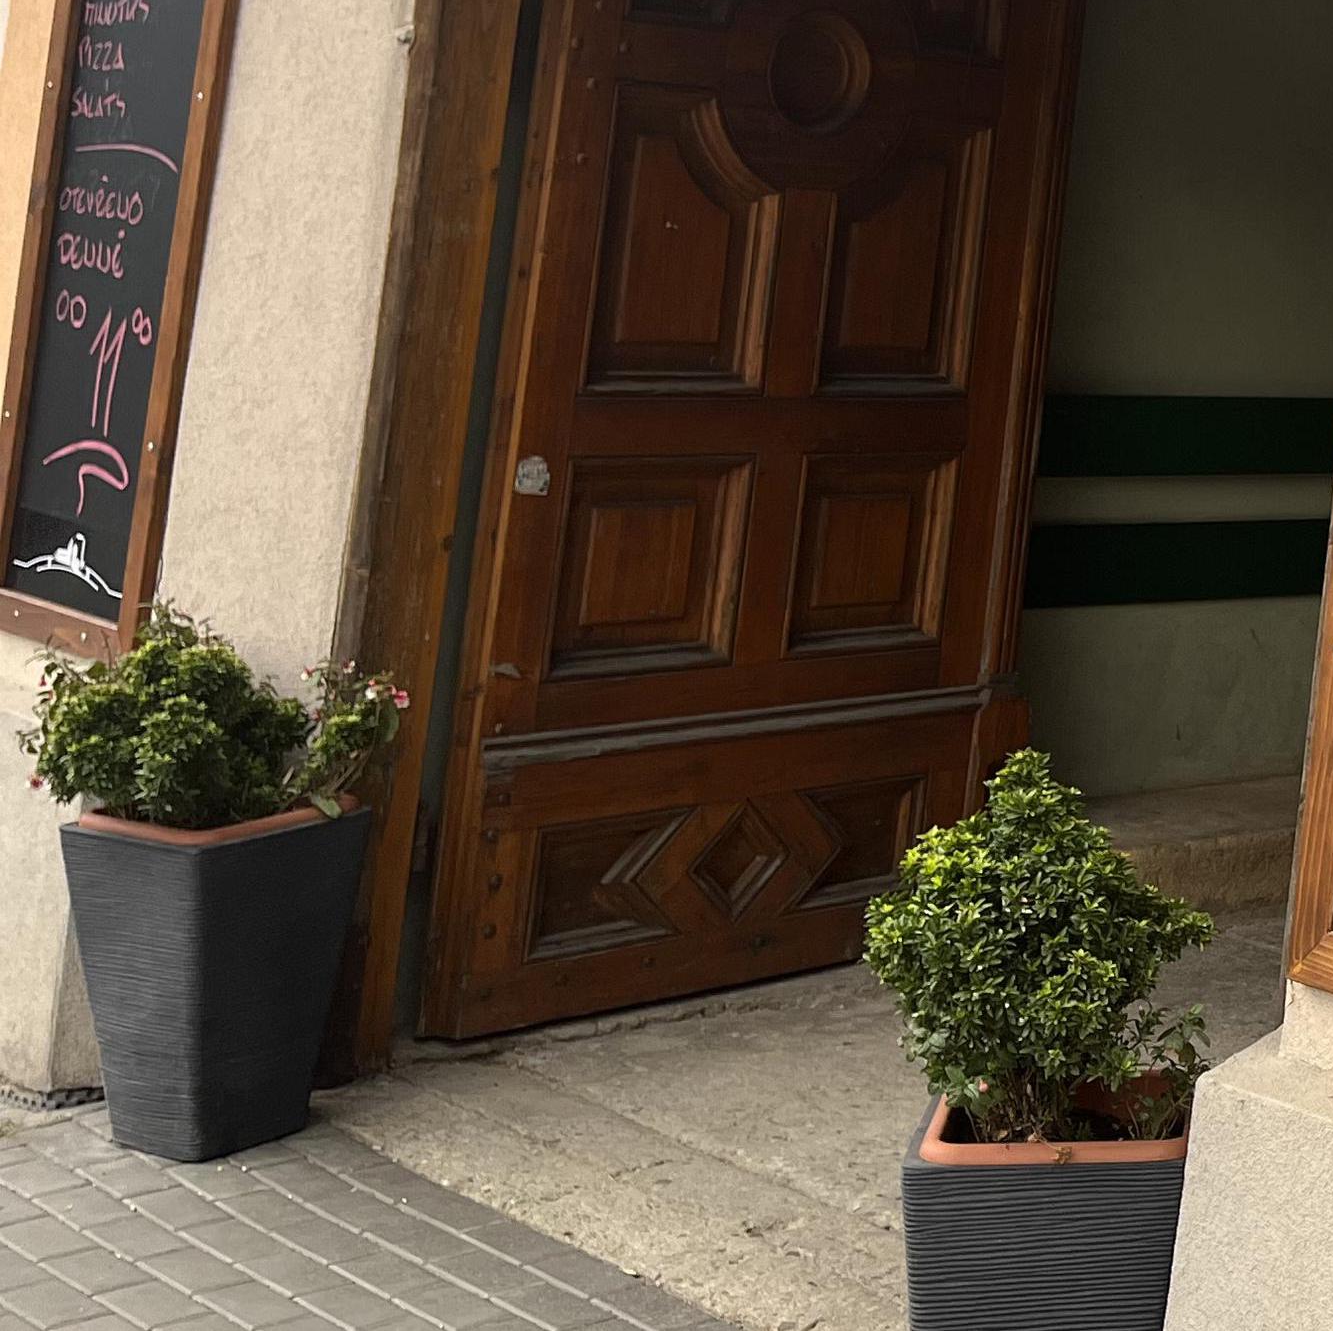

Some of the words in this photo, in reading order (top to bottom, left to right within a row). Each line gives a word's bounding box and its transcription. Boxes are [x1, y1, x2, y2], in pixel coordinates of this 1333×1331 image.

[77, 35, 126, 72] PIZZA
[71, 78, 126, 119] SALÁTY
[59, 174, 144, 226] OTEVŘENO
[57, 229, 126, 280] DENNÍ
